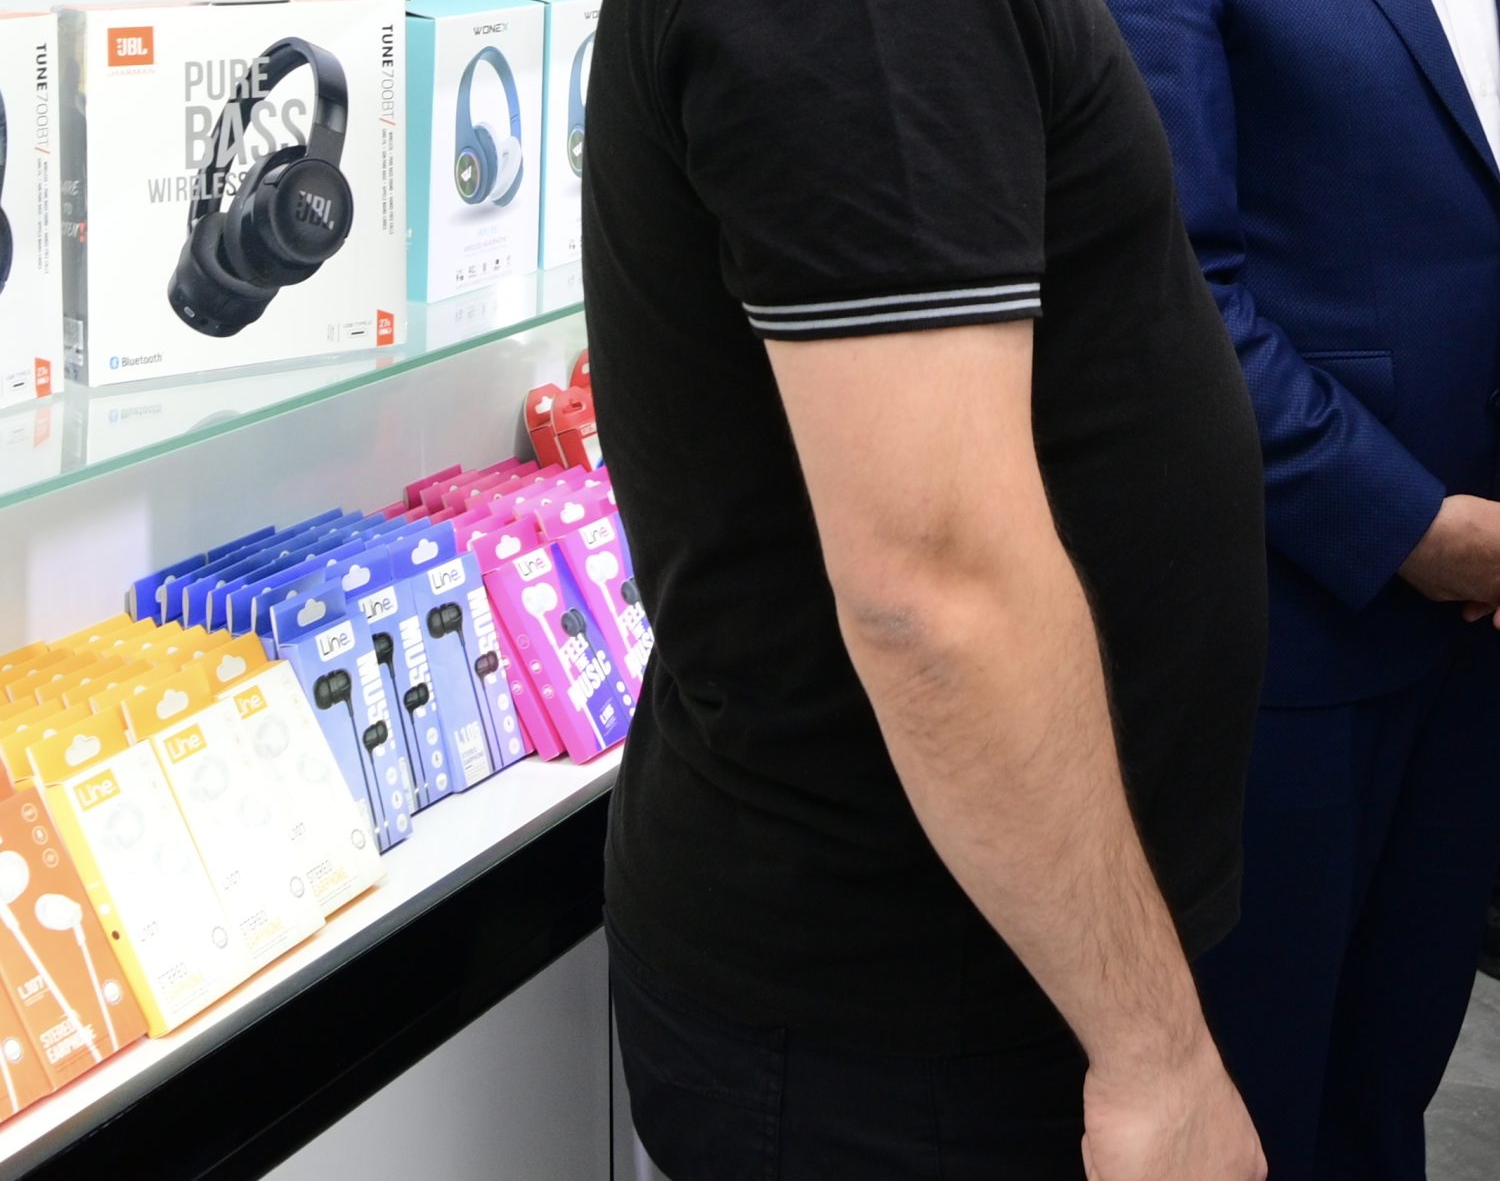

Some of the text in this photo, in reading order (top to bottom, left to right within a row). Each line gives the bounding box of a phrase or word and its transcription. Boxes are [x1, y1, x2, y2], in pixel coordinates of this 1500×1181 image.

[116, 37, 148, 56] JBL
[184, 56, 270, 102] PURE
[184, 98, 307, 170] BASS
[121, 353, 163, 368] Bluetooth
[432, 568, 459, 590] Line
[320, 631, 351, 656] Line
[567, 650, 612, 713] MUSIC
[168, 733, 202, 760] Line
[78, 779, 115, 807] Line
